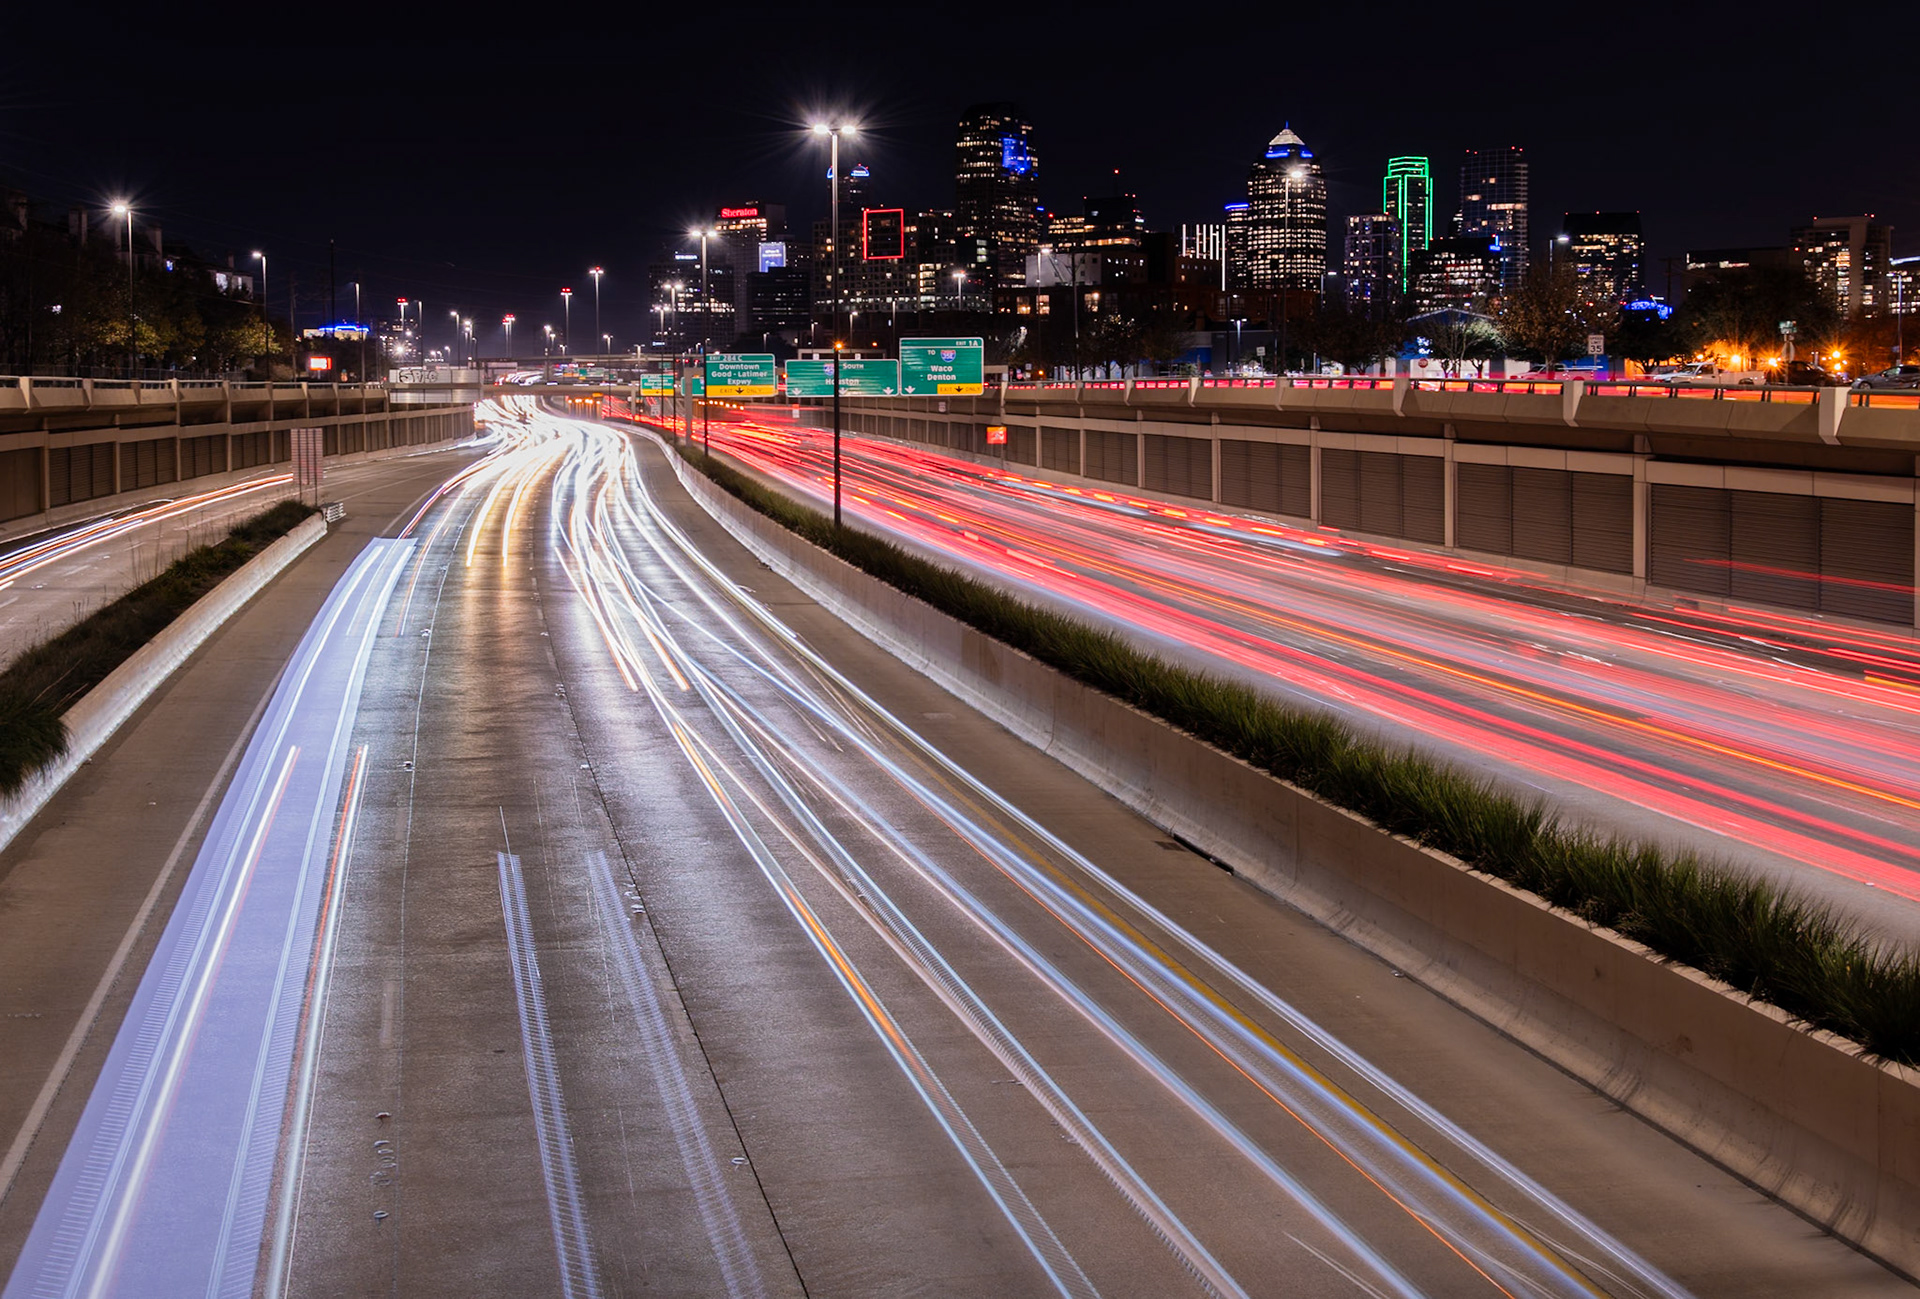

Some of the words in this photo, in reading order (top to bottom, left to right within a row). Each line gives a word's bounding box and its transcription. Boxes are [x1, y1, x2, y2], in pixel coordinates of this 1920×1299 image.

[721, 207, 758, 218] Sheraton
[1590, 345, 1602, 353] 35
[927, 373, 956, 381] Denton
